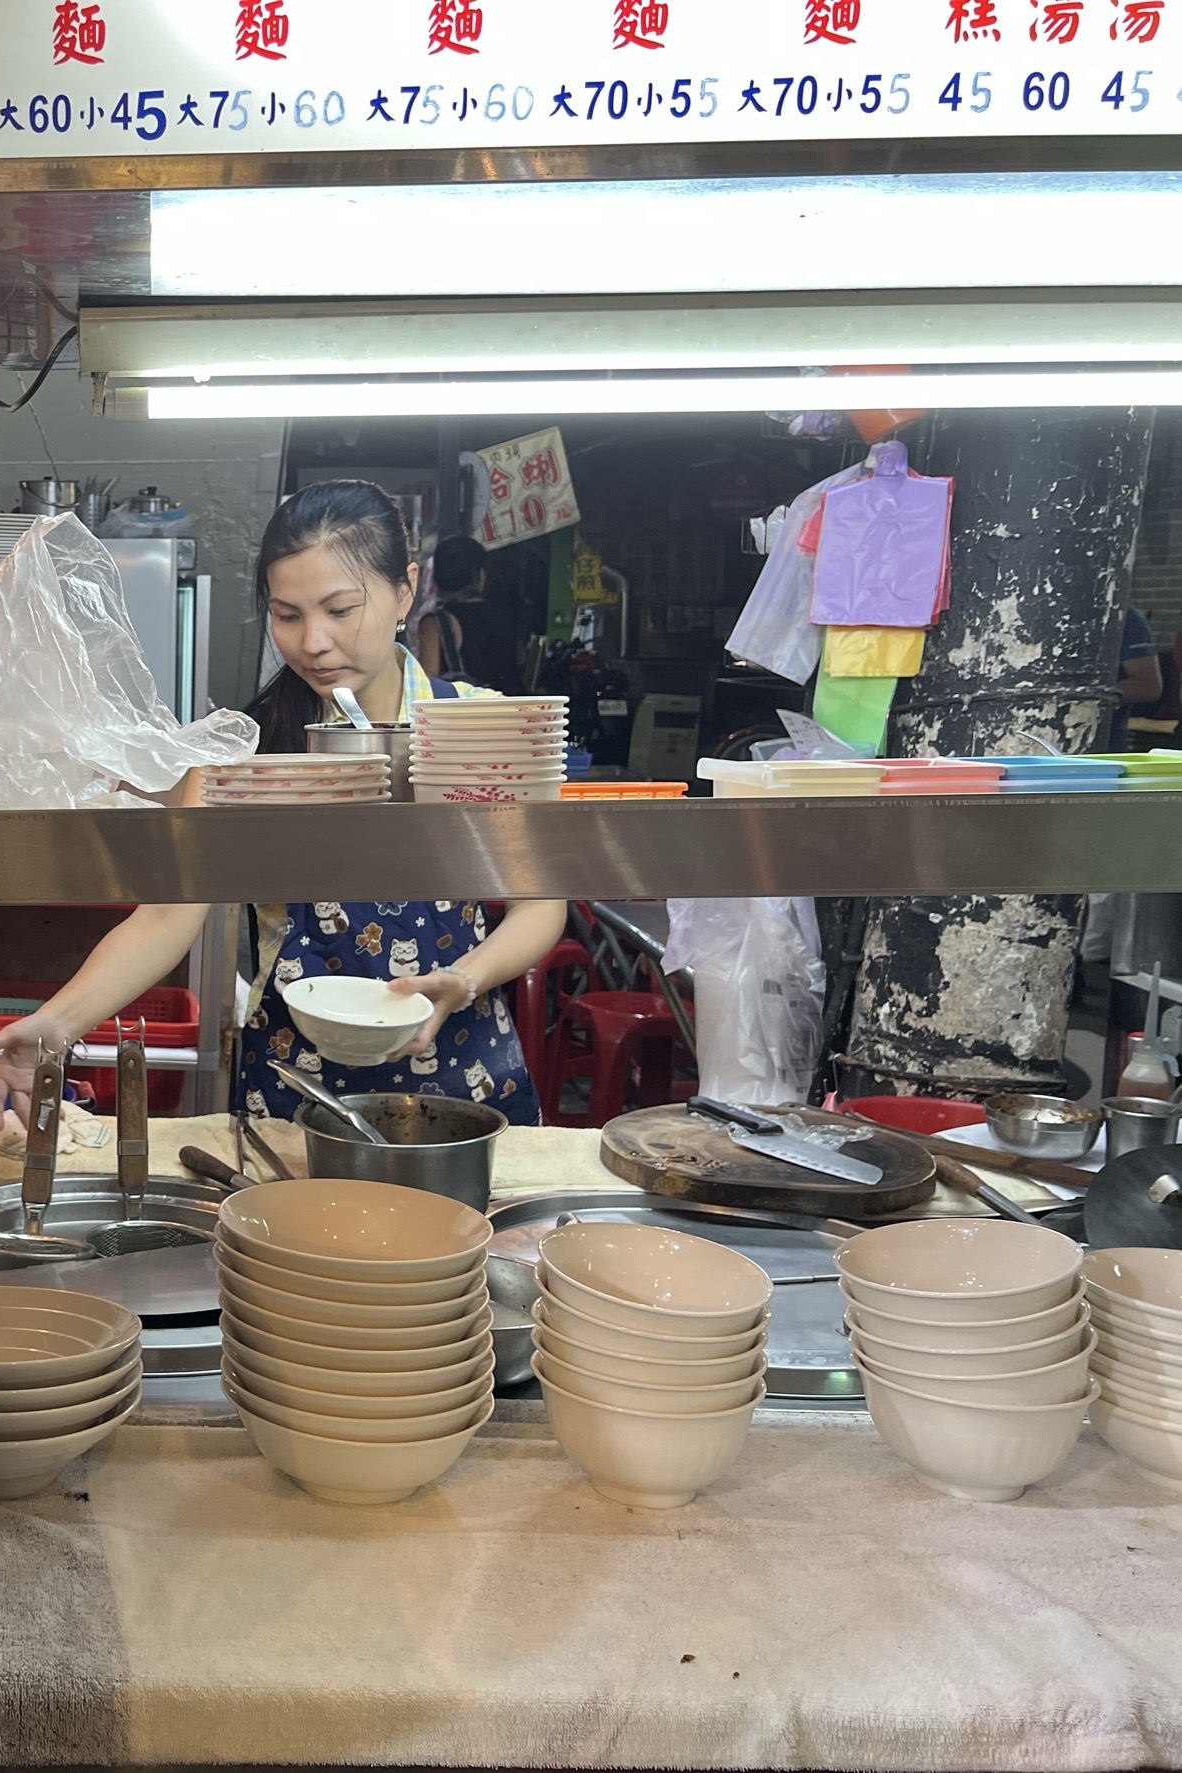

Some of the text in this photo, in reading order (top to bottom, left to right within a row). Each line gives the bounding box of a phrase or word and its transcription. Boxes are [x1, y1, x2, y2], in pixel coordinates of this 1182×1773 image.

[52, 0, 106, 66] 麵
[234, 0, 289, 61] 麵
[427, 0, 483, 56] 麵
[612, 0, 669, 50] 麵
[802, 0, 861, 45] 麵
[938, 71, 992, 113] 45
[1022, 71, 1070, 112] 60
[1100, 70, 1153, 112] 45
